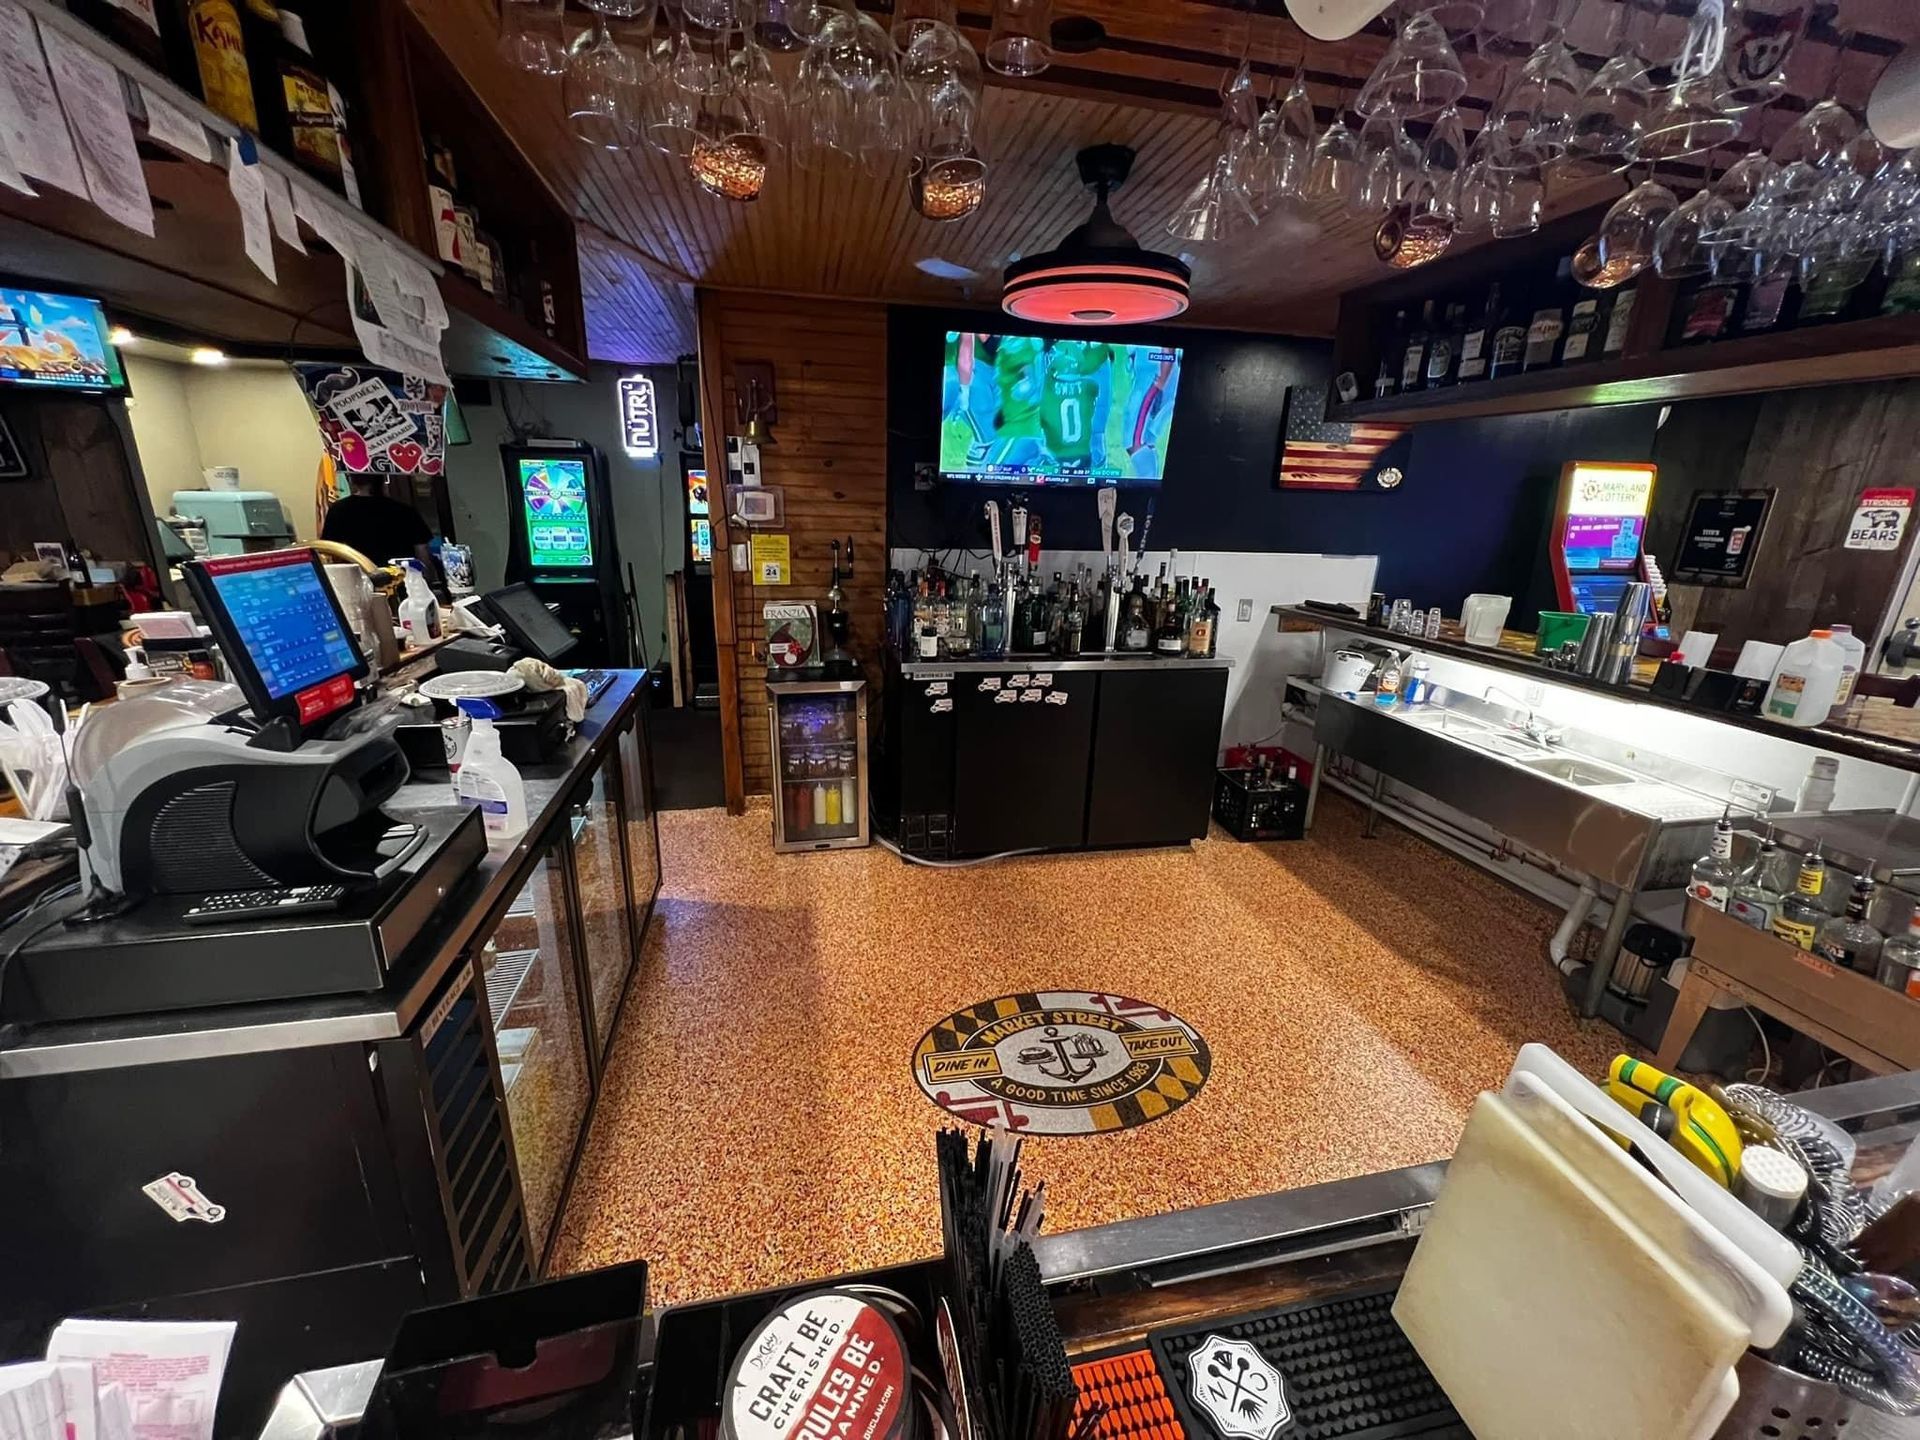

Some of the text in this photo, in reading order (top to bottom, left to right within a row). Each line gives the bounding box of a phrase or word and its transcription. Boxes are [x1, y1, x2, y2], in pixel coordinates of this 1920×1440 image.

[1060, 398, 1082, 444] 0
[1599, 493, 1637, 502] LOTTERY
[1601, 482, 1647, 493] MARYLAND
[1850, 529, 1899, 541] BEARS
[765, 607, 808, 619] FRANZIA
[980, 1011, 1125, 1045] MARKET STREET
[933, 1057, 991, 1074] DINE IN
[990, 1060, 1150, 1102] A GOOD TIME SINCE 1983
[748, 1310, 829, 1422] CRAFT BE
[841, 1332, 875, 1369] BE
[773, 1319, 845, 1430] CHERISHED.
